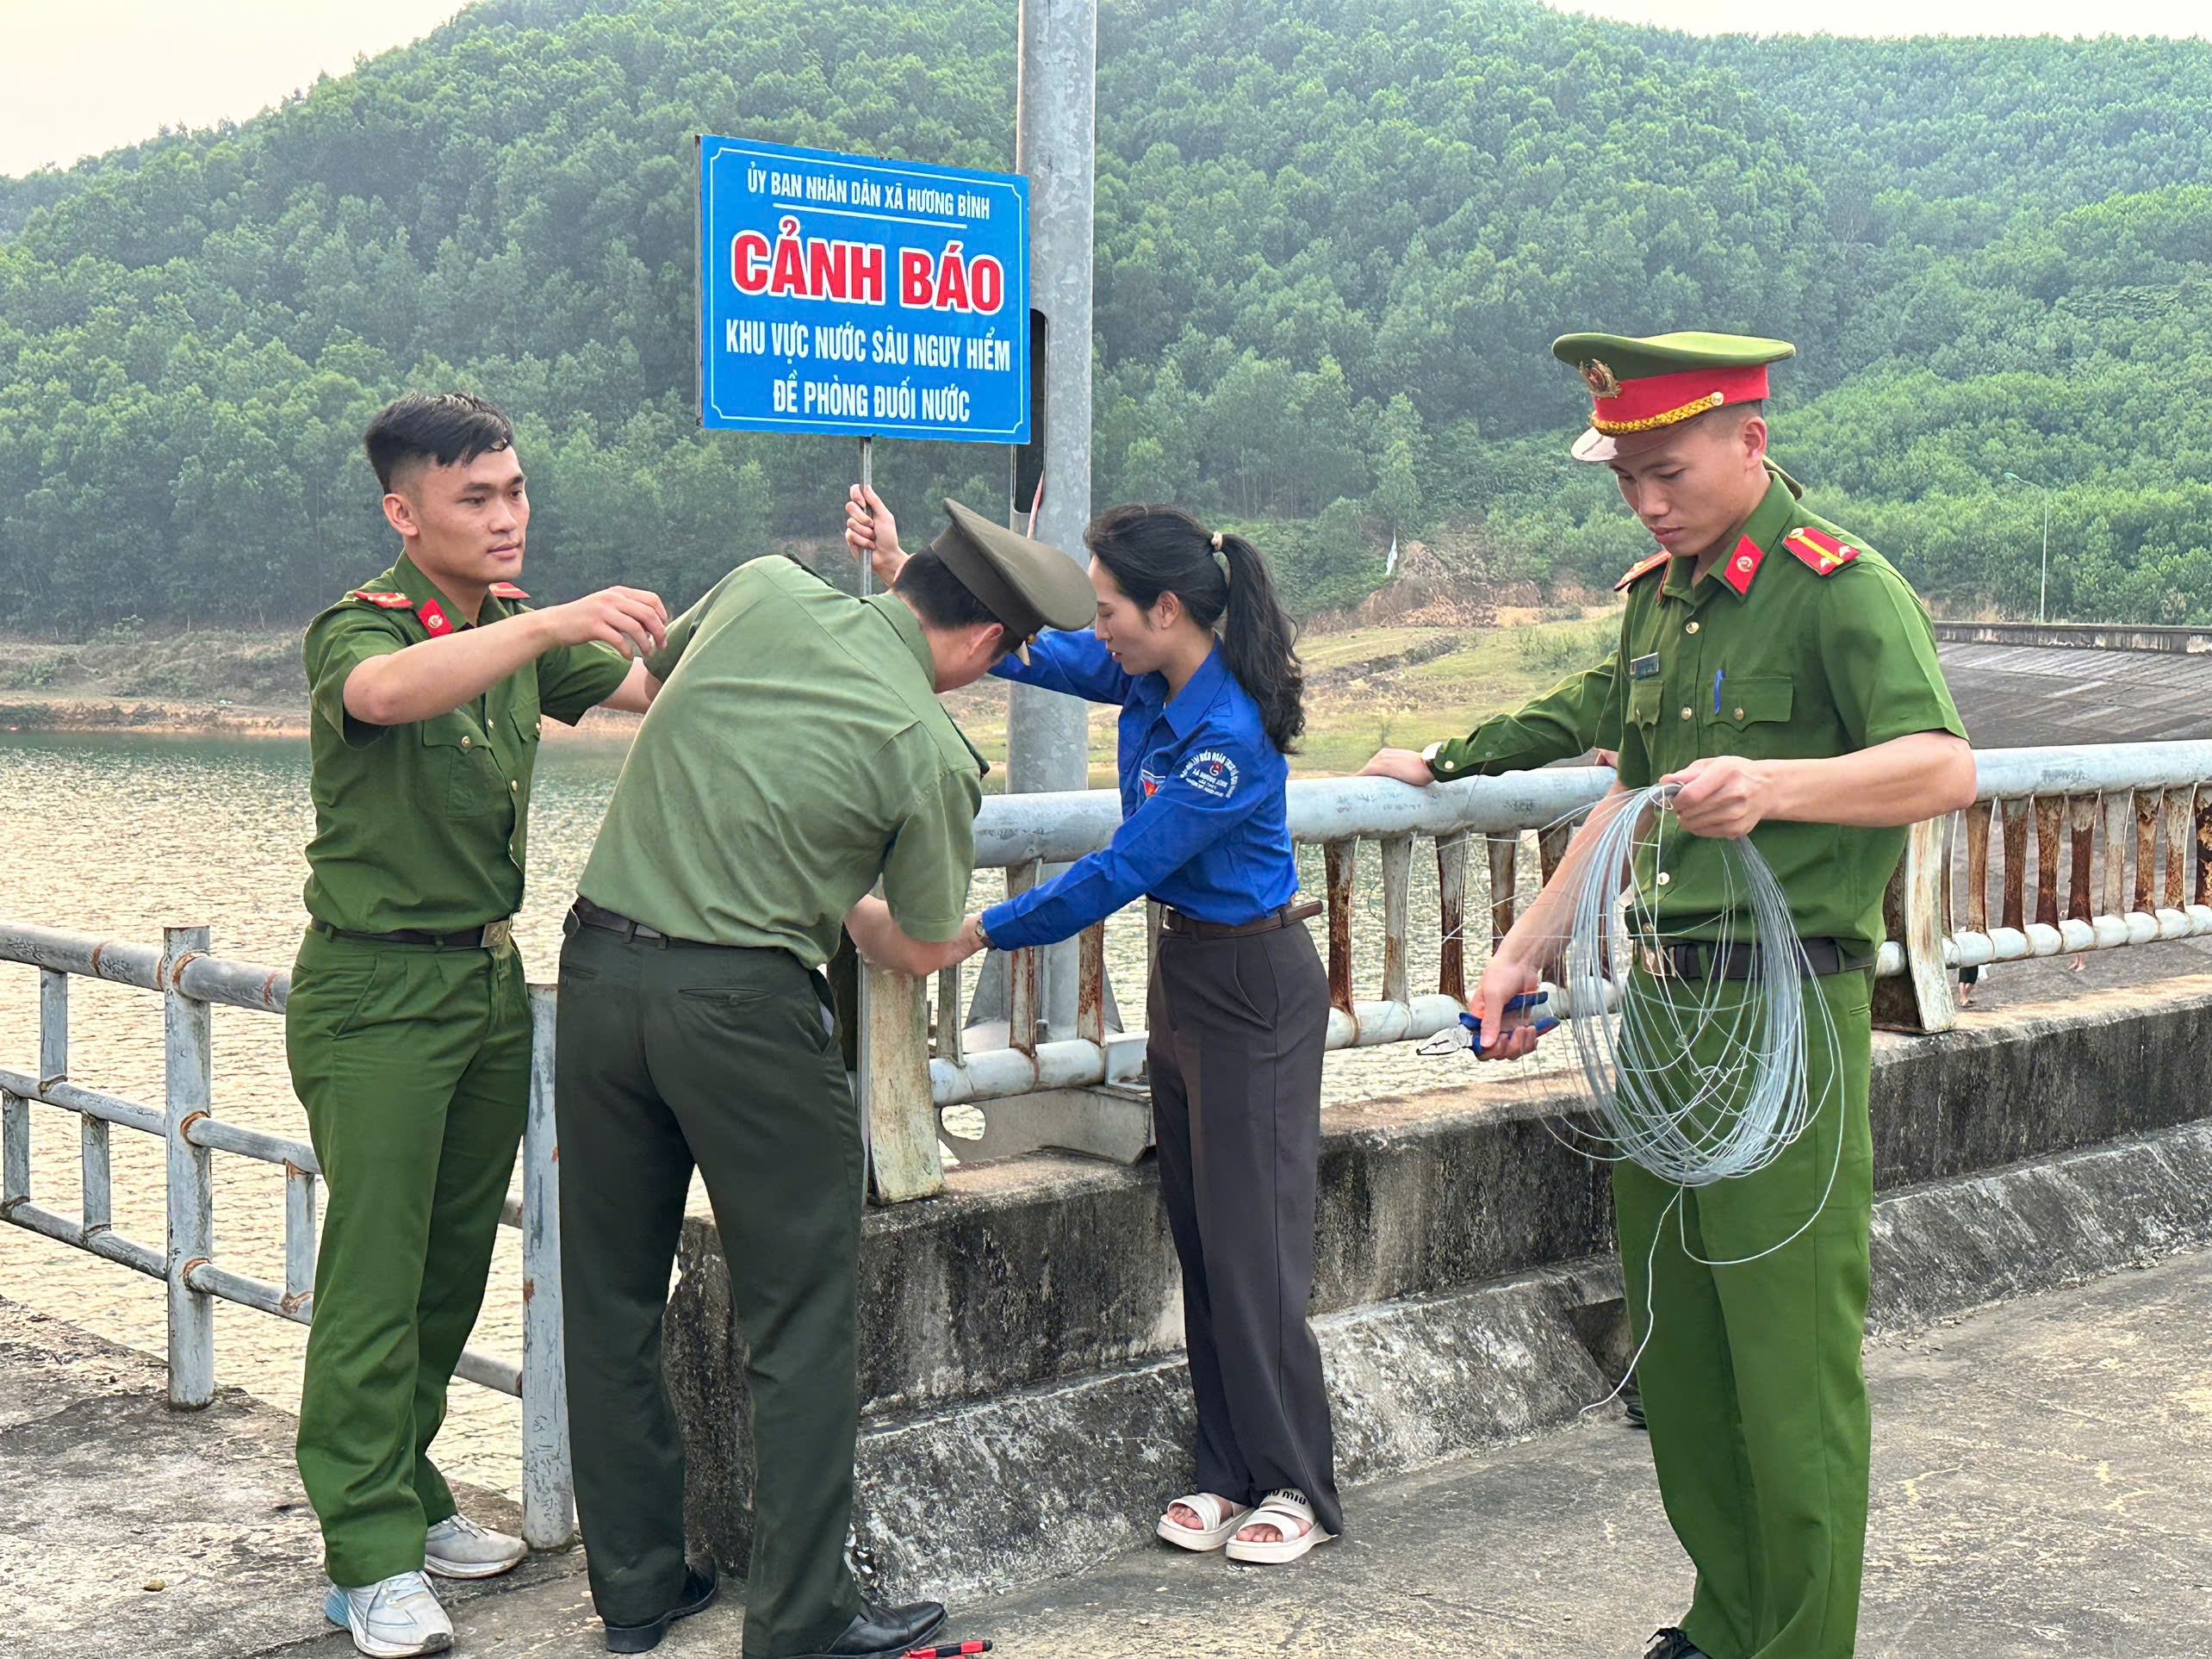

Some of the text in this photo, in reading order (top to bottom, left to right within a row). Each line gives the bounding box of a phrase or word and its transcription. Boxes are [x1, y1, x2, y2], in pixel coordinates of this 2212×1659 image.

[748, 161, 991, 221] ỦY BAN NHÂN DÂN XÃ HƯƠNG BÌNH
[732, 215, 1003, 314] CẢNH BÁO
[726, 319, 1010, 372] KHU VỰC NƯỚC SÂU NGUY HIỂM
[773, 369, 970, 422] ĐỀ PHÒNG ĐUỐI NƯỚC
